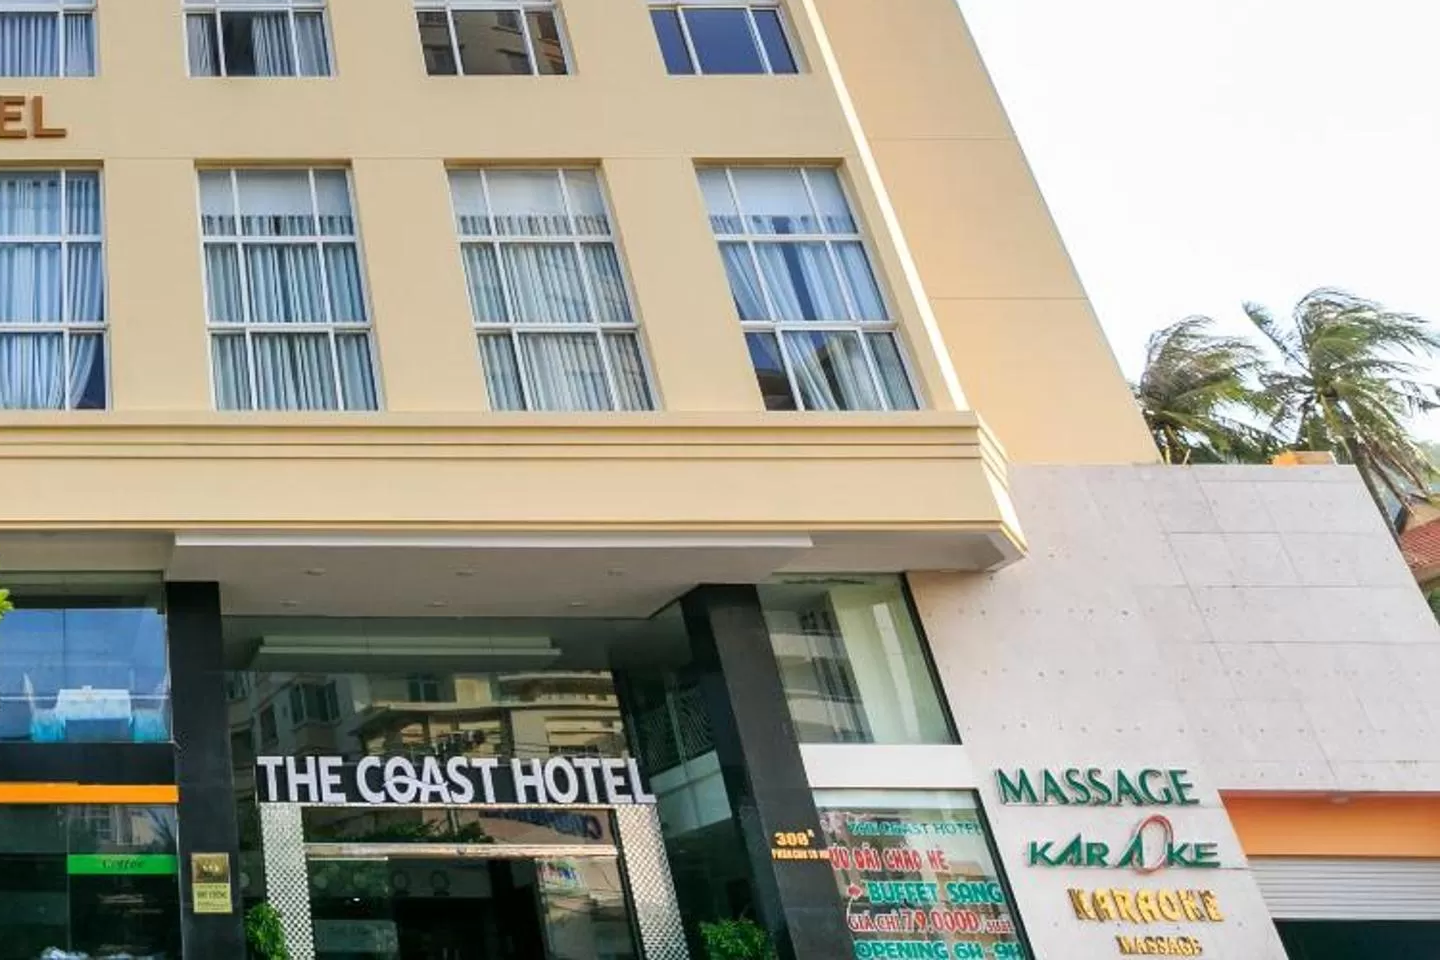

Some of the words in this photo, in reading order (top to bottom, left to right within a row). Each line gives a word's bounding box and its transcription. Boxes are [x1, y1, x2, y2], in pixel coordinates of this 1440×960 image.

[257, 755, 348, 803] THE
[356, 755, 500, 804] COAST
[510, 756, 658, 804] HOTEL
[994, 767, 1200, 807] MASSAGE
[867, 880, 939, 904] BUFFET
[1067, 888, 1224, 924] KARAOKE
[854, 940, 949, 960] OPENING
[1115, 935, 1204, 956] MASSAGE
